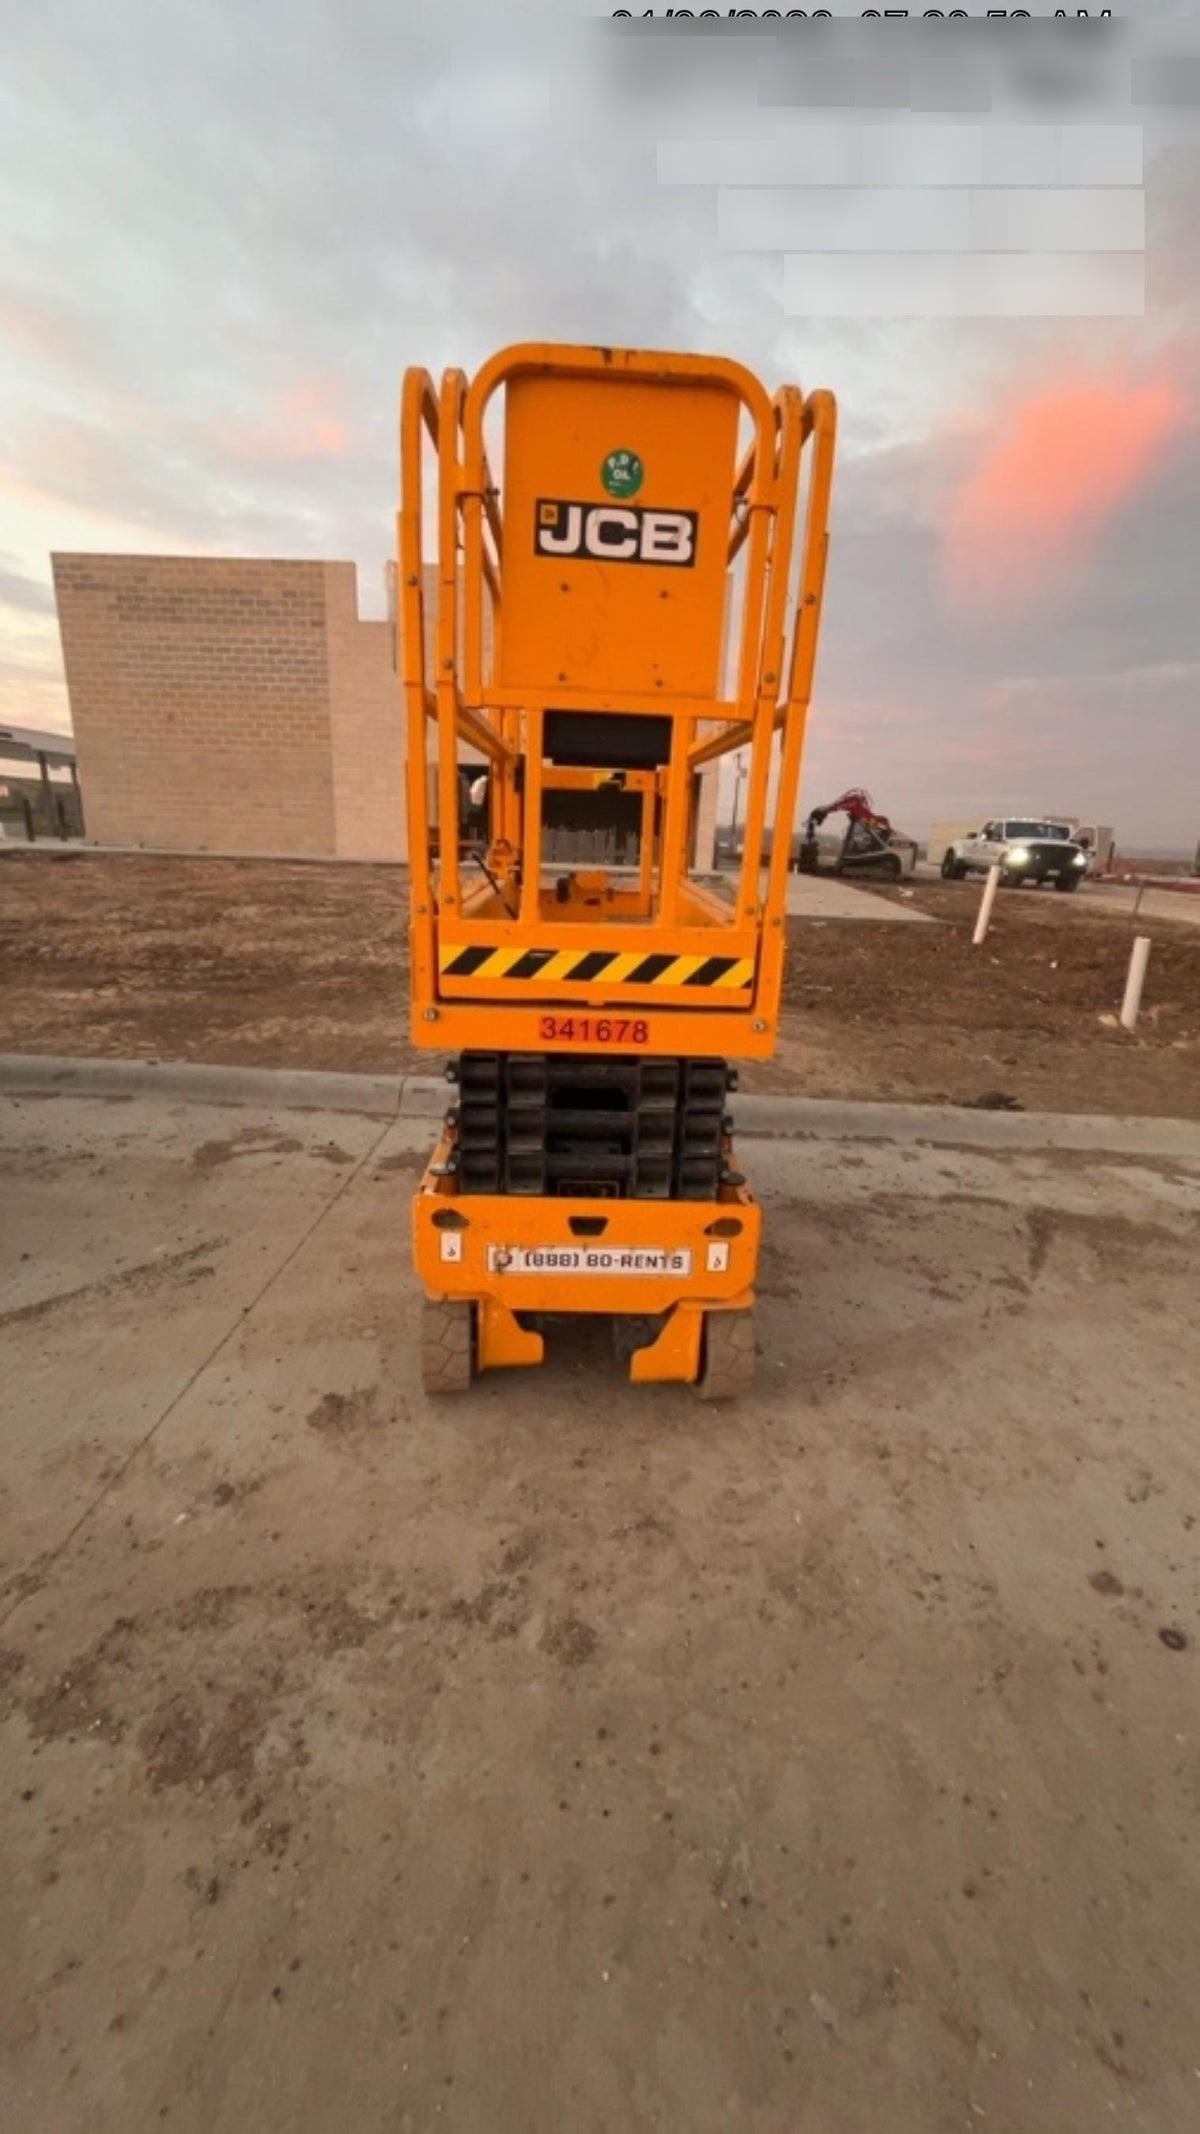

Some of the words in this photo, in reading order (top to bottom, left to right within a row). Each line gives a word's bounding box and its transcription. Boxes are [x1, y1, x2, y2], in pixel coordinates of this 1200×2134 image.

[539, 505, 693, 563] JCB
[541, 1017, 649, 1044] 341678
[525, 1253, 579, 1267] (888)
